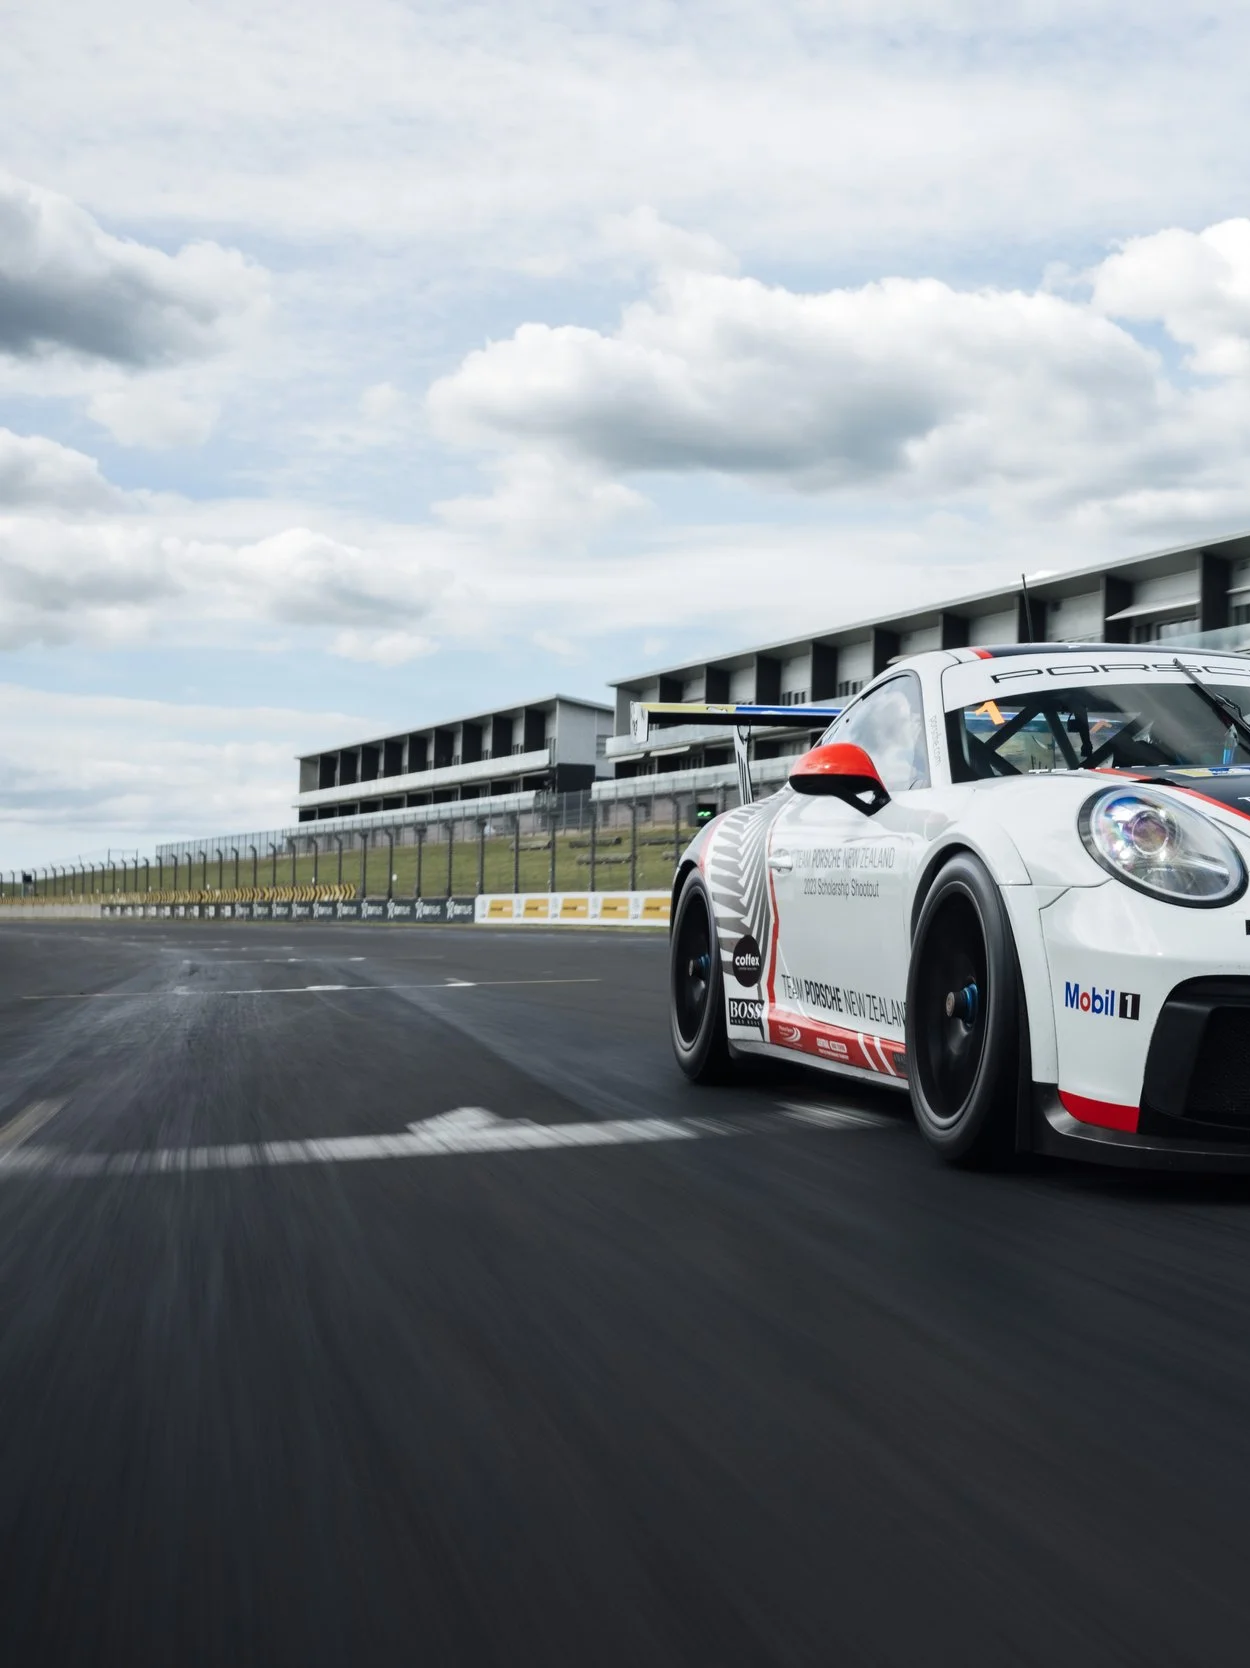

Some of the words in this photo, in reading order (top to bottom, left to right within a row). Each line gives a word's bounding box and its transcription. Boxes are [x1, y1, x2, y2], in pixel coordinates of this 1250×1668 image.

[975, 700, 1005, 725] 1
[812, 847, 843, 868] PORSCHE
[843, 847, 860, 868] NEW
[859, 847, 896, 868] ZEALAND
[804, 878, 817, 895] 2023
[818, 878, 850, 900] Scholarship
[852, 878, 880, 898] Shootout
[735, 952, 760, 967] coffex
[730, 1000, 763, 1020] BOSS
[781, 973, 805, 1002] TEAM
[804, 979, 844, 1013] PORSCHE
[843, 988, 866, 1018] NEW
[865, 994, 907, 1028] ZEALAN
[1064, 981, 1116, 1017] Mobil
[1123, 993, 1135, 1019] 1
